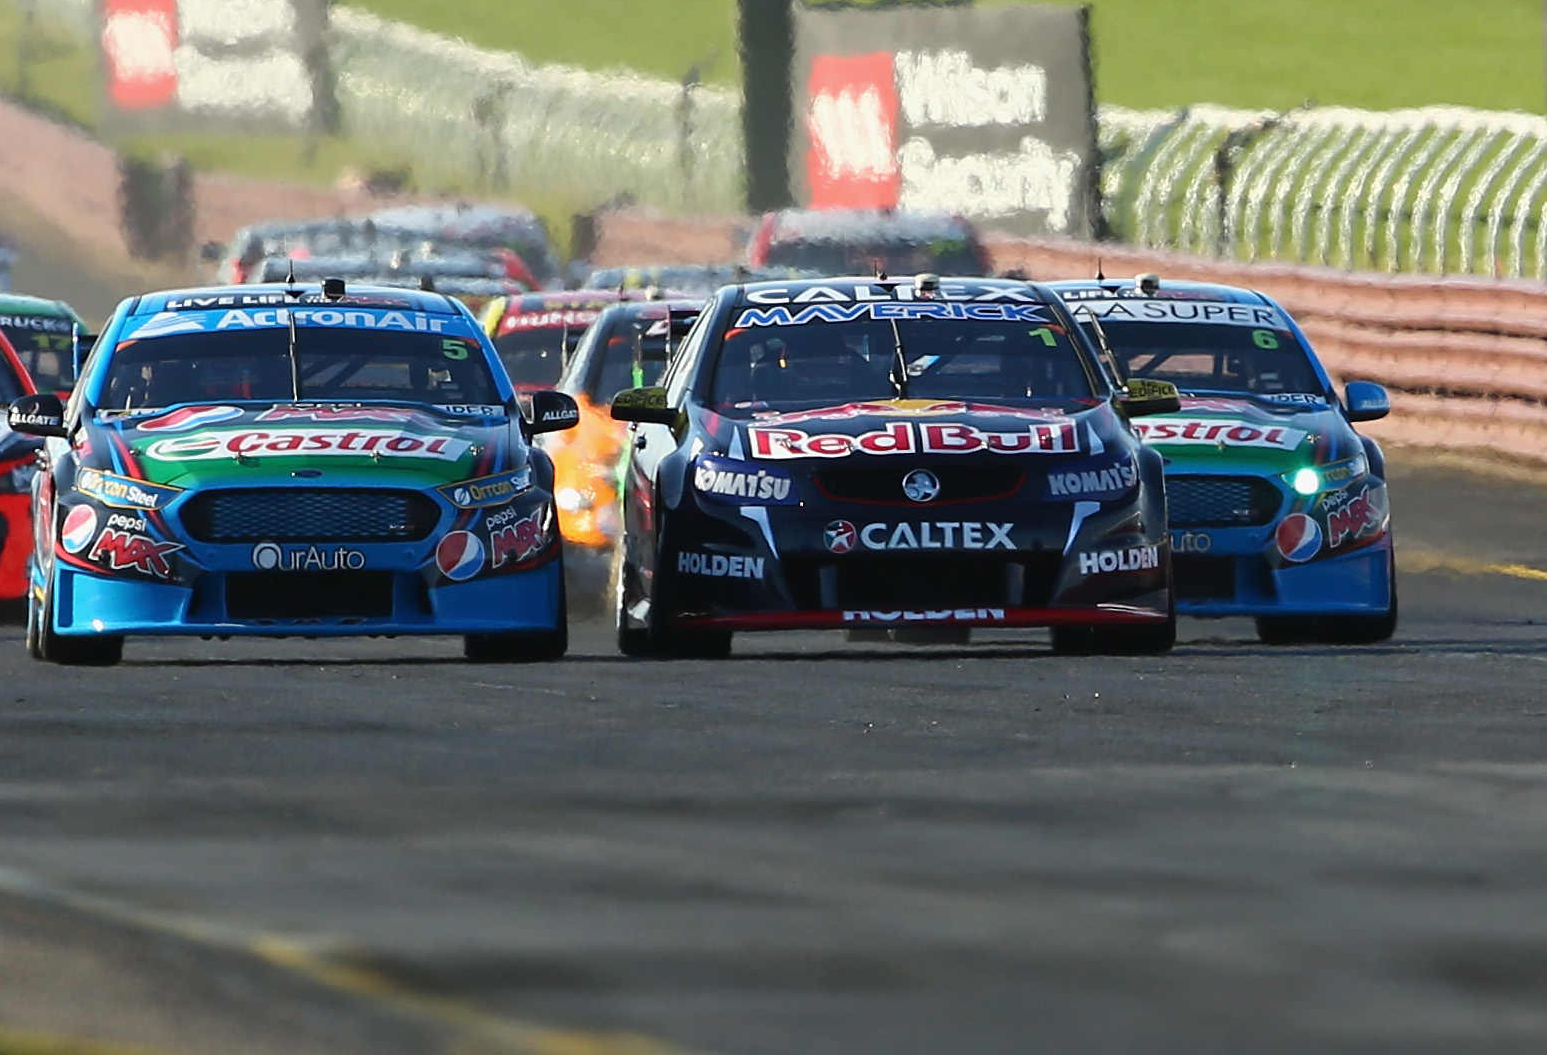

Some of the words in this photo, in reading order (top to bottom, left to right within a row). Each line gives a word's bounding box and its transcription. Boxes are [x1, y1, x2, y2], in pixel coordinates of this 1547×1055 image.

[166, 295, 234, 309] LIVE
[747, 284, 1037, 304] CALTEX
[217, 309, 450, 333] ActronAir
[735, 302, 1050, 328] MAVERICK
[1072, 303, 1137, 318] AA
[1144, 302, 1276, 326] SUPER
[1028, 327, 1058, 347] 1
[1252, 329, 1280, 350] 6
[442, 339, 469, 361] 5
[615, 394, 666, 406] EDIFICE
[1129, 386, 1175, 398] EDIFICE
[9, 413, 59, 425] ALLGATE
[542, 410, 578, 422] ALLGAT
[226, 431, 447, 455] Castrol
[748, 421, 916, 459] Red
[918, 417, 1079, 454] Bull
[1134, 422, 1285, 445] astrol
[694, 466, 792, 501] KOMATSU
[1047, 462, 1138, 495] KOMATS
[107, 513, 148, 532] pepsi
[485, 505, 517, 531] pepsi
[491, 506, 553, 570] MAX
[861, 521, 1017, 550] CALTEX
[87, 527, 187, 579] MAX
[252, 541, 366, 571] OurAuto
[677, 551, 765, 579] HOLDEN
[1078, 546, 1159, 575] HOLDEN
